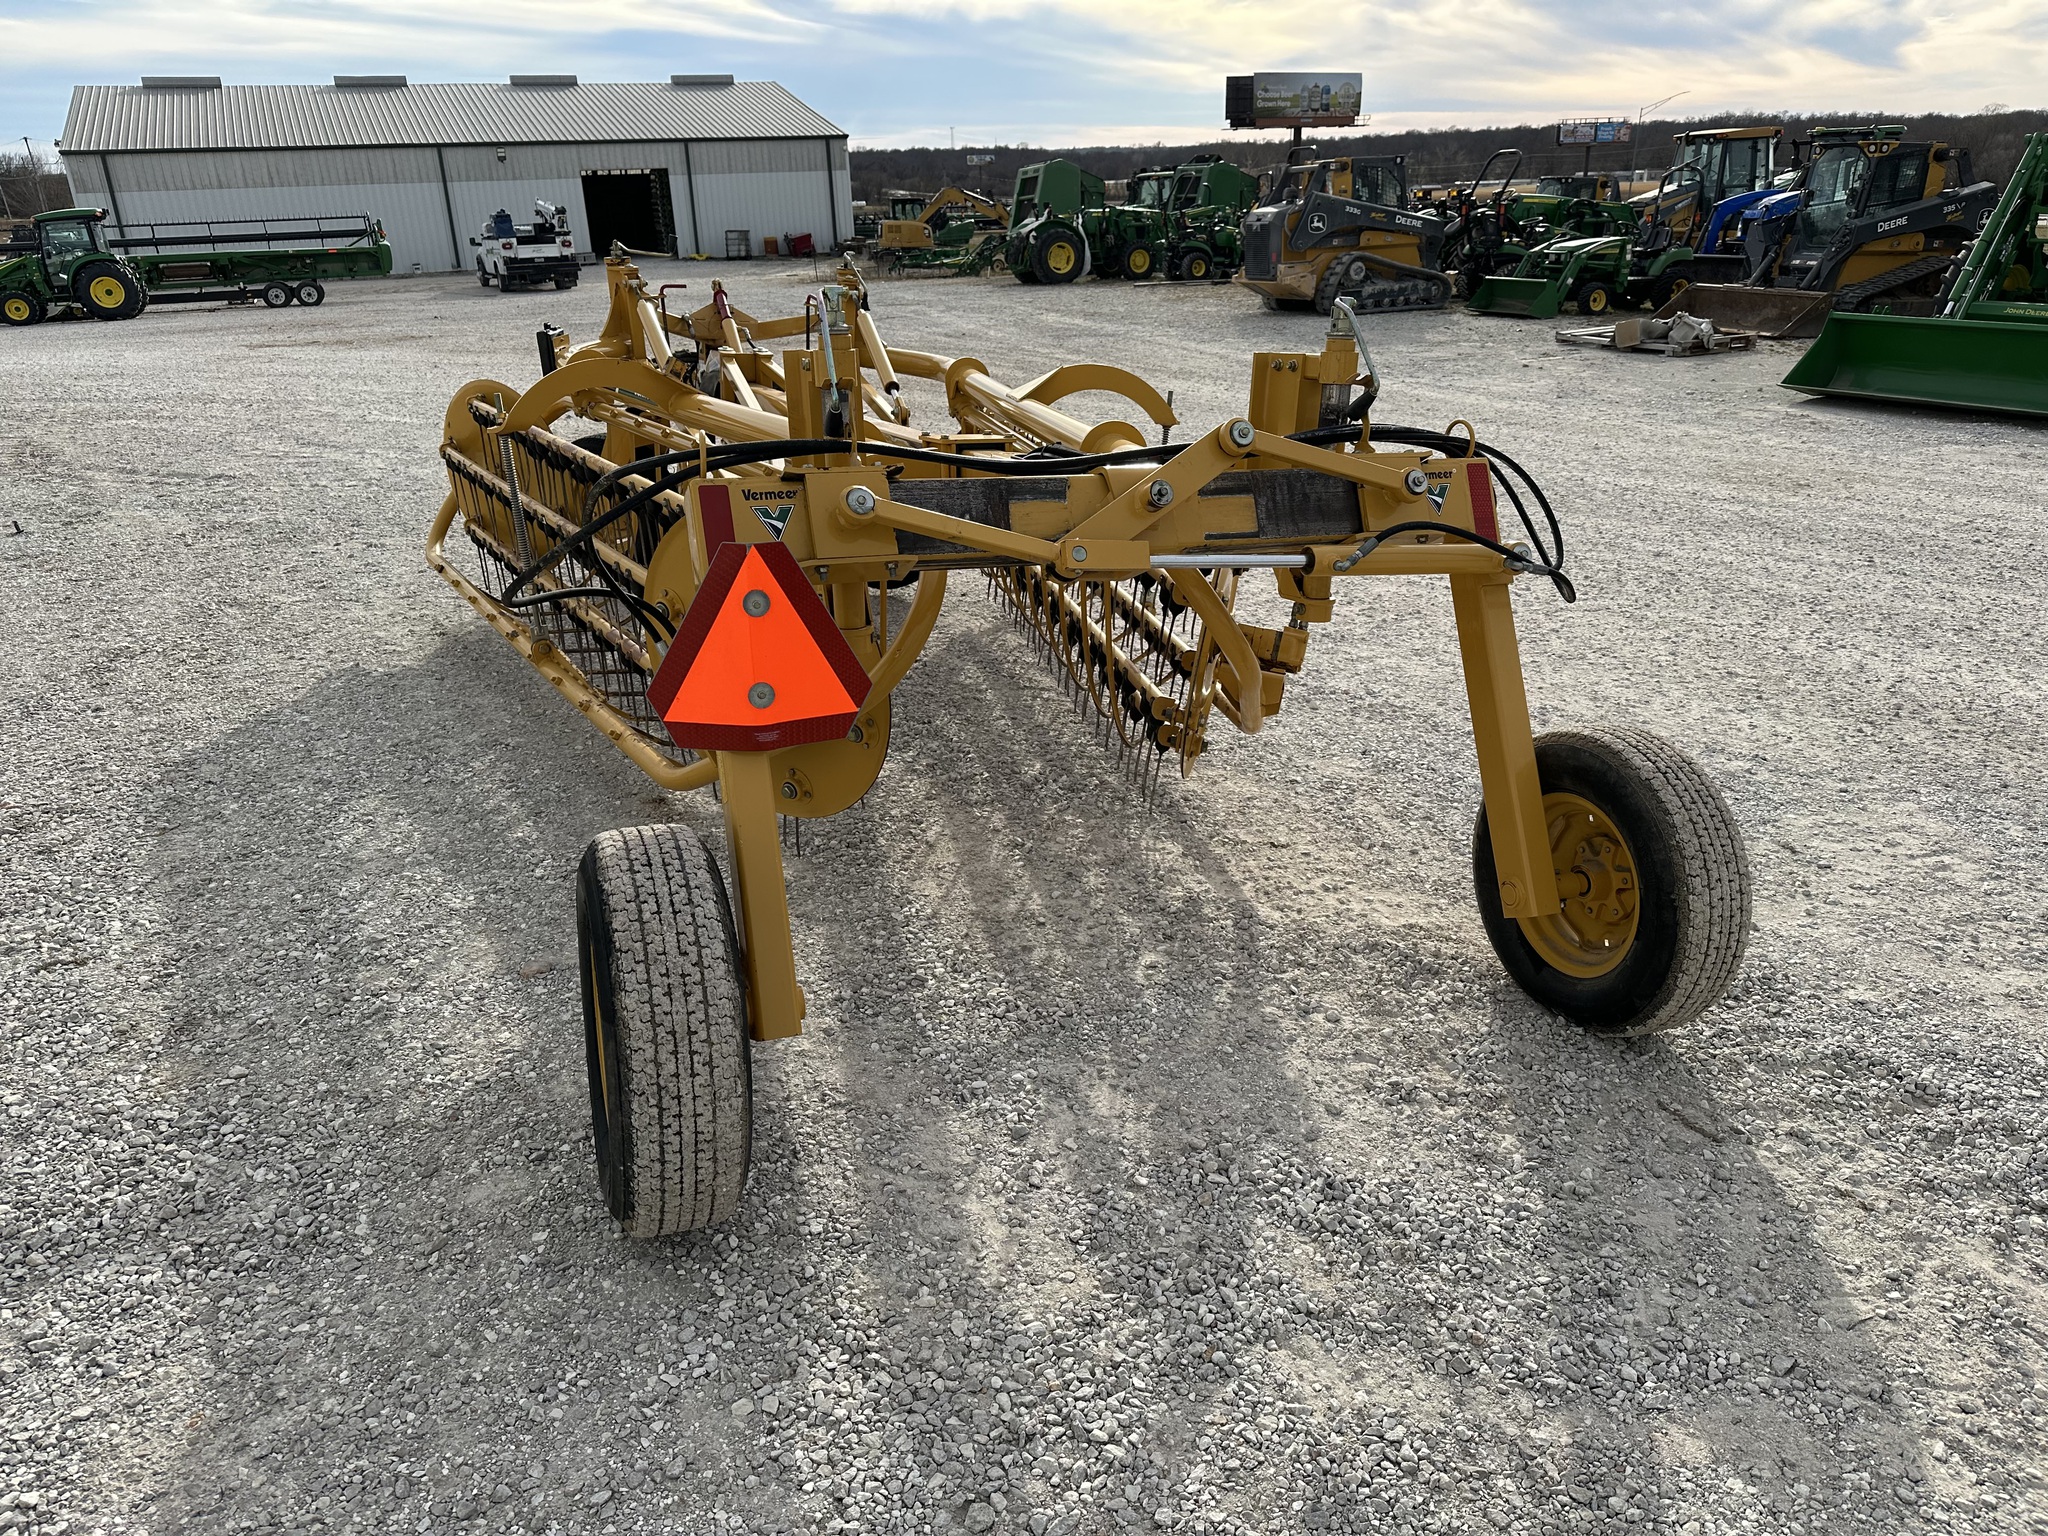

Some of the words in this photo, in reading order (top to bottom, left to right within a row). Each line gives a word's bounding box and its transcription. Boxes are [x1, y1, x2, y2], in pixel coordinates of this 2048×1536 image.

[1345, 205, 1361, 215] 333G
[1395, 214, 1423, 228] DEERE
[1877, 215, 1908, 233] DEERE
[2003, 307, 2024, 315] JOHN
[1425, 470, 1453, 480] rmeer
[741, 488, 798, 501] Vermeer
